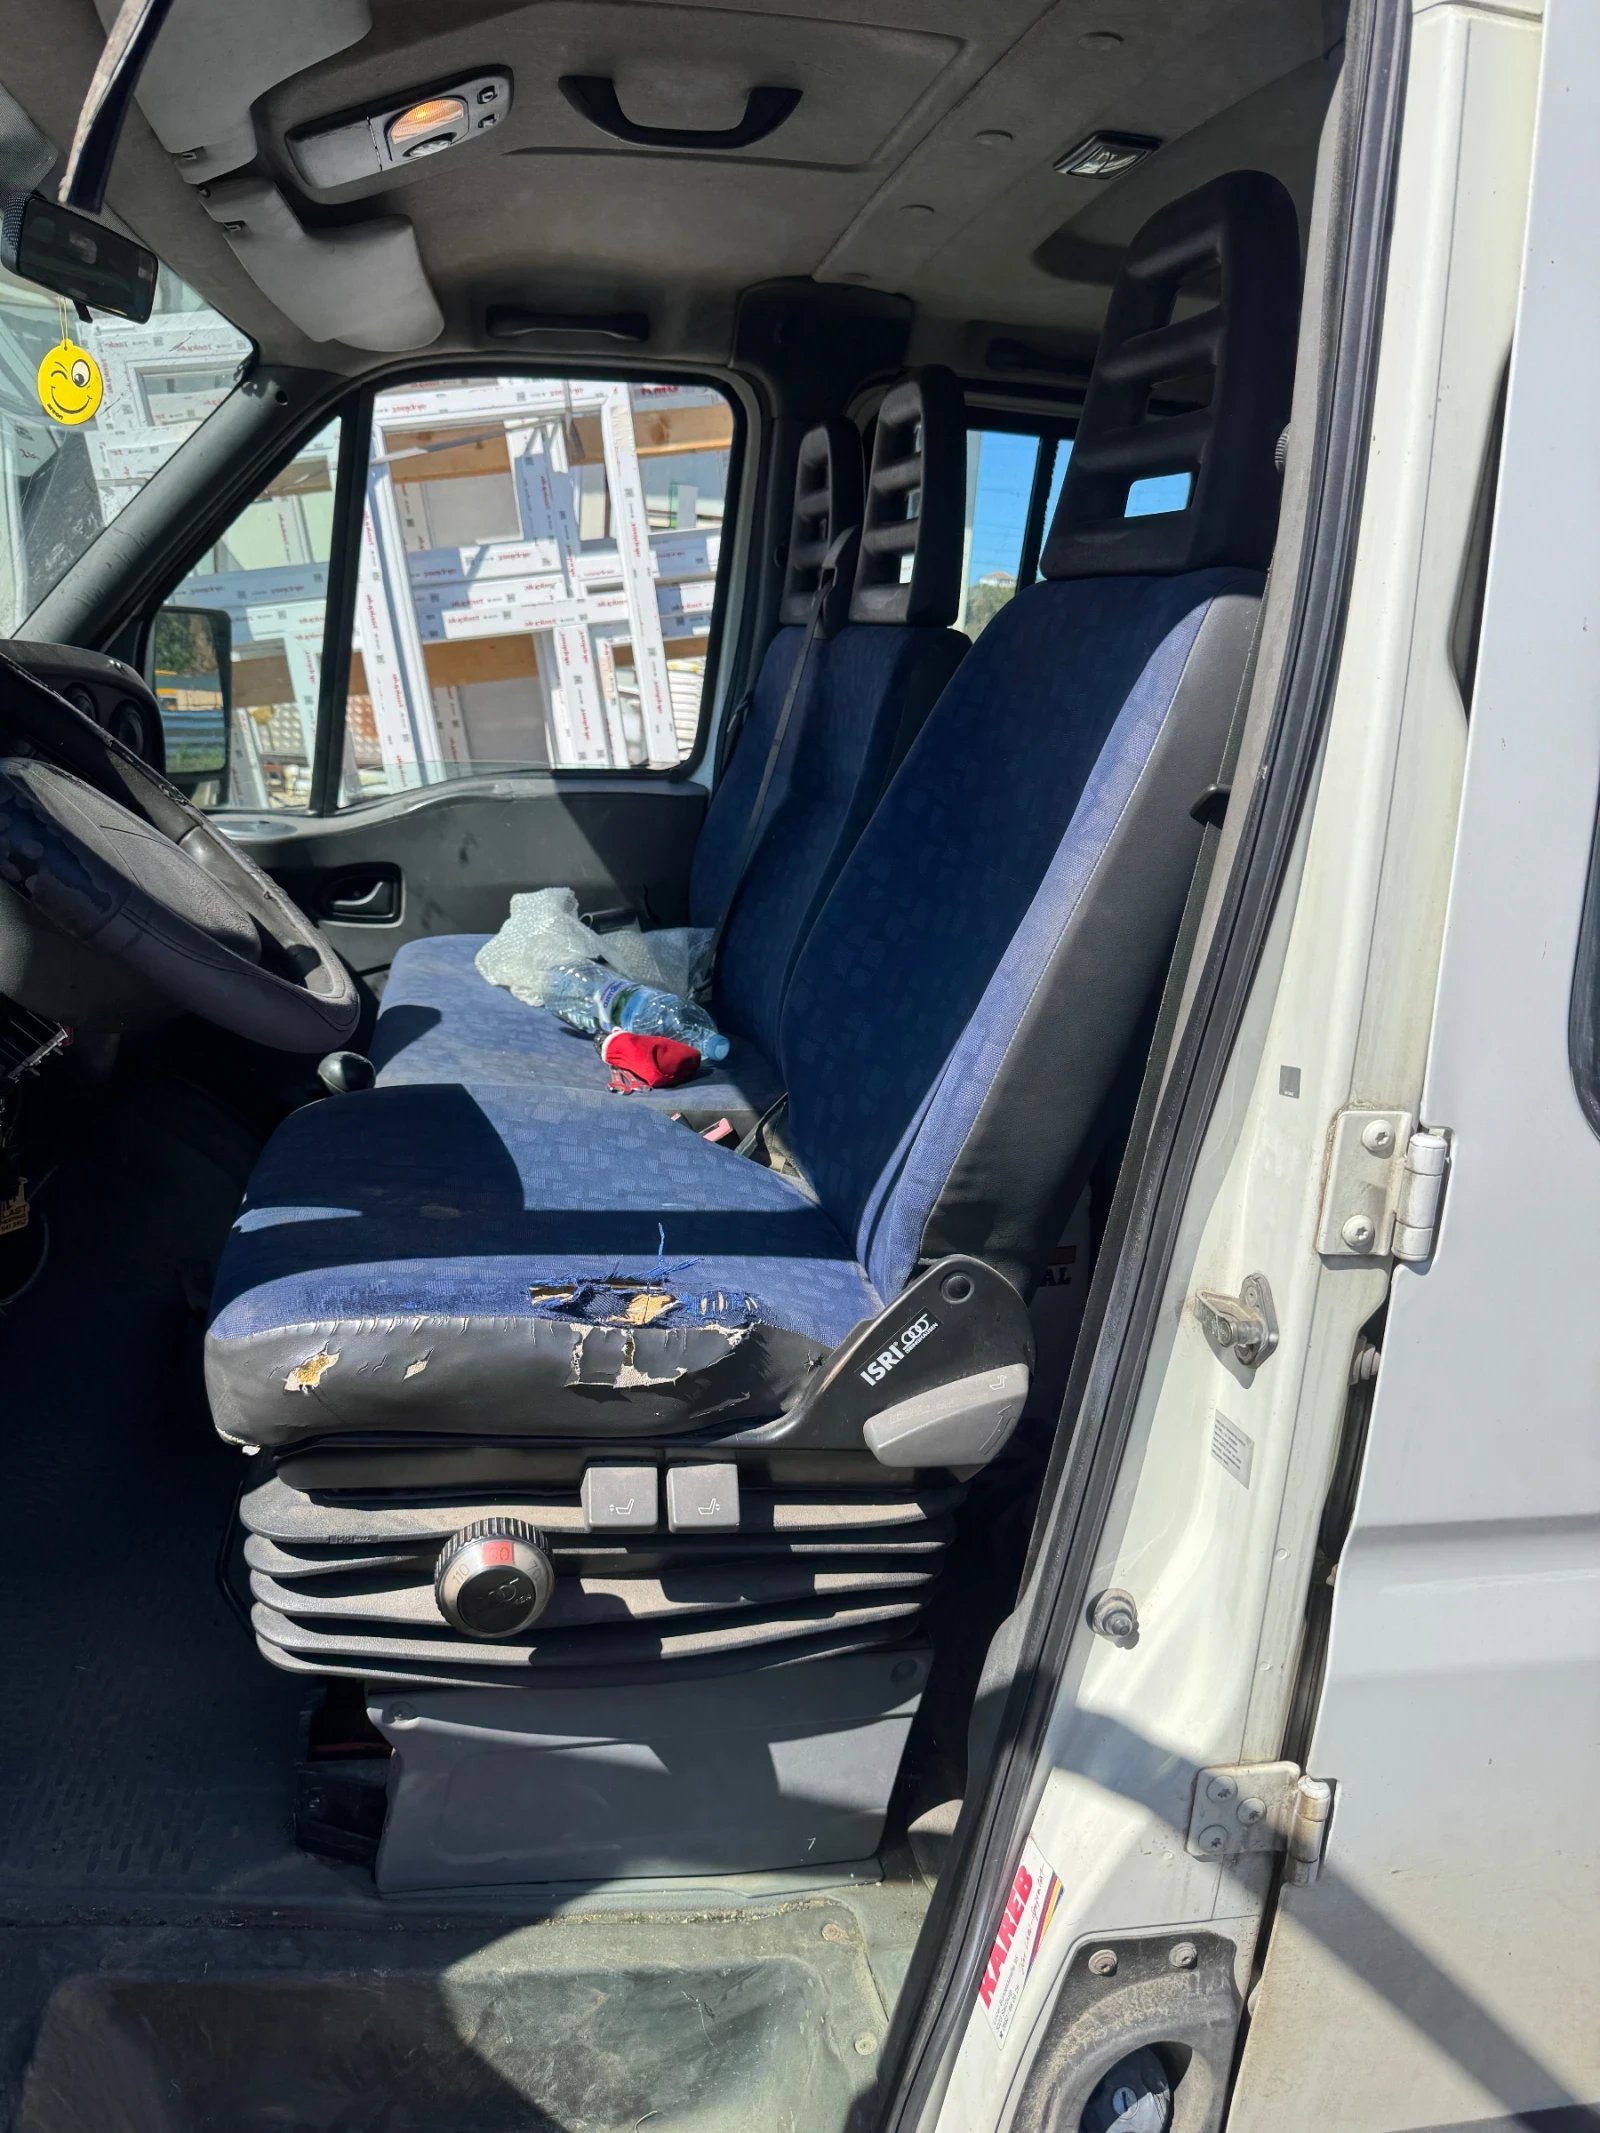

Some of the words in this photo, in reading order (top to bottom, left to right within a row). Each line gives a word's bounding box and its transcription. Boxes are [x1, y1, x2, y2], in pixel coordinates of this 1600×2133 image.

[47, 403, 64, 420] areon
[452, 1563, 470, 1584] 110
[979, 1865, 1033, 2010] KAREB
